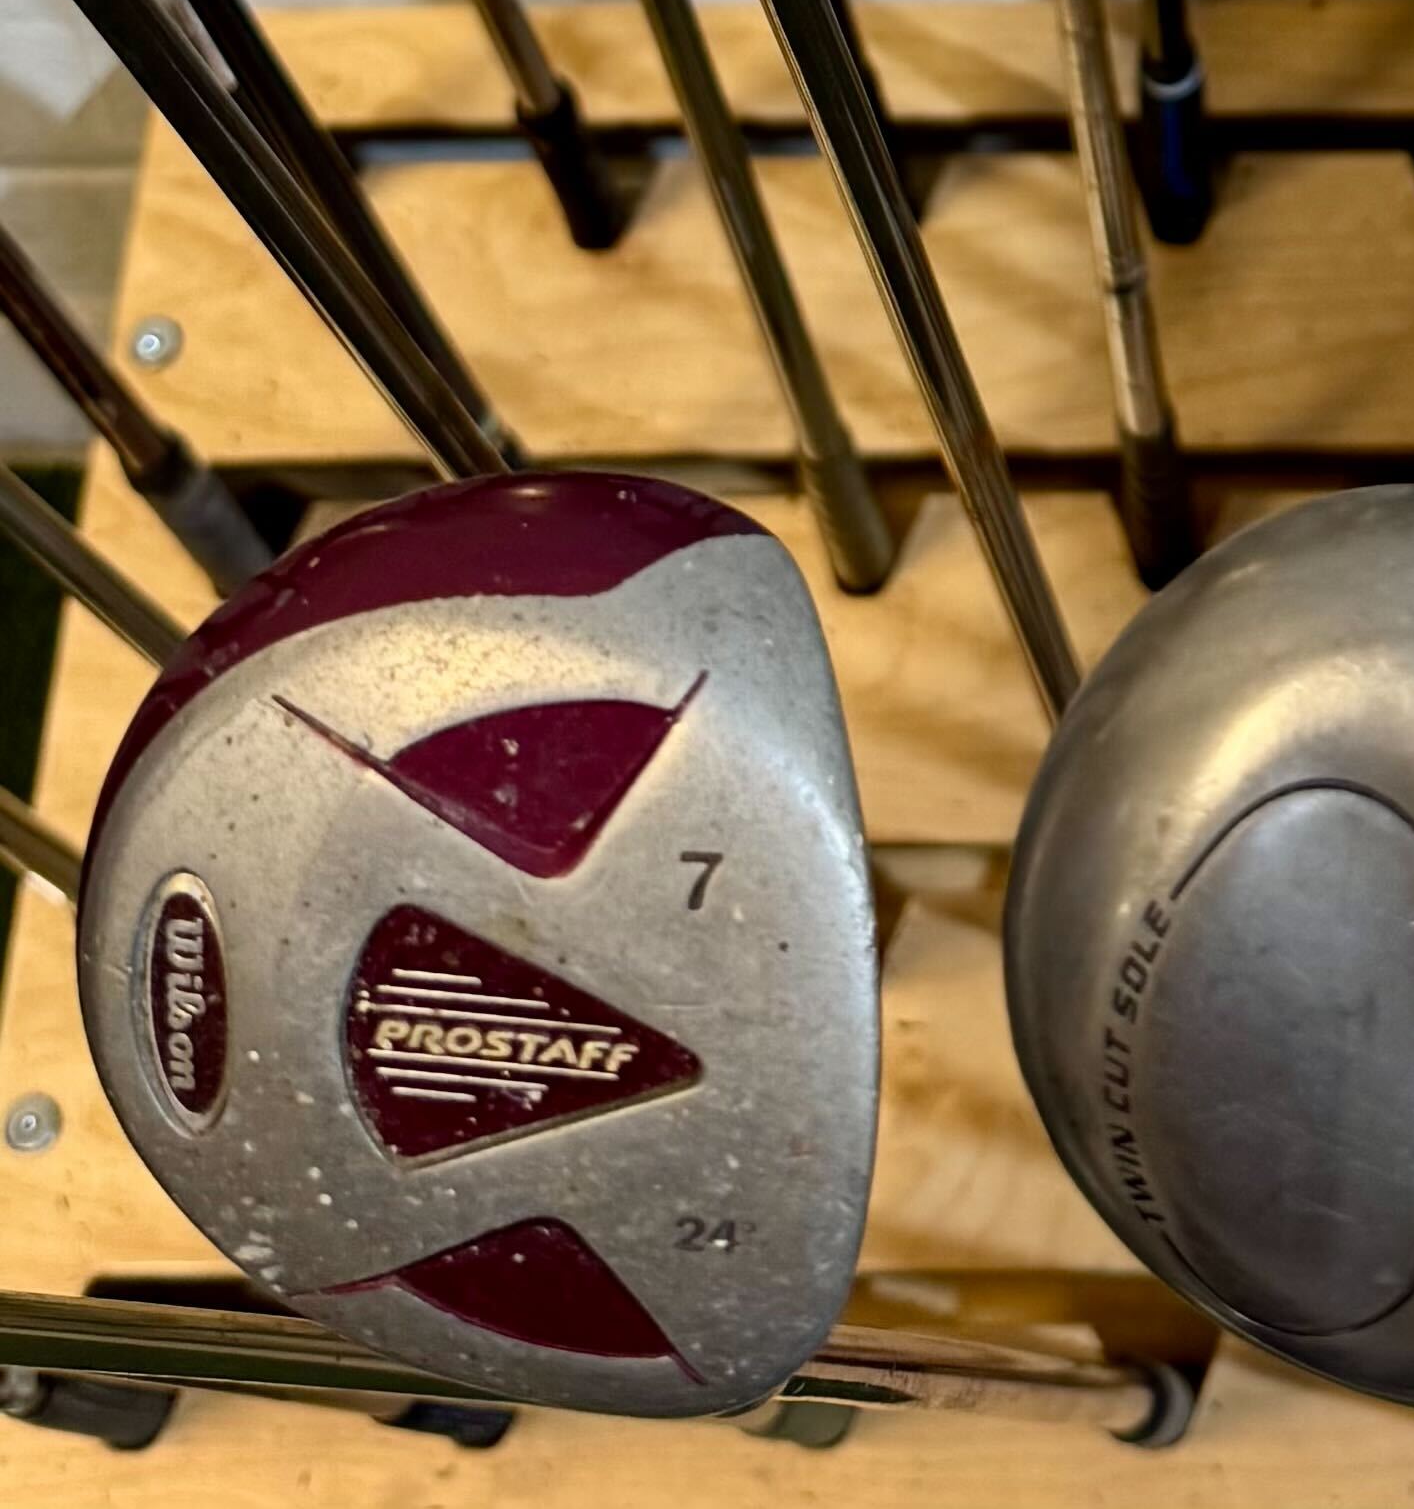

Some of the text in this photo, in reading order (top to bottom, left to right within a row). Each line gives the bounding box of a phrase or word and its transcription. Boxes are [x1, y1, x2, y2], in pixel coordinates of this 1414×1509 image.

[679, 851, 724, 911] 7
[164, 917, 204, 1092] Wilson
[375, 1019, 640, 1072] PROSTAFF
[1104, 899, 1173, 1225] TWIN CUT SOLE
